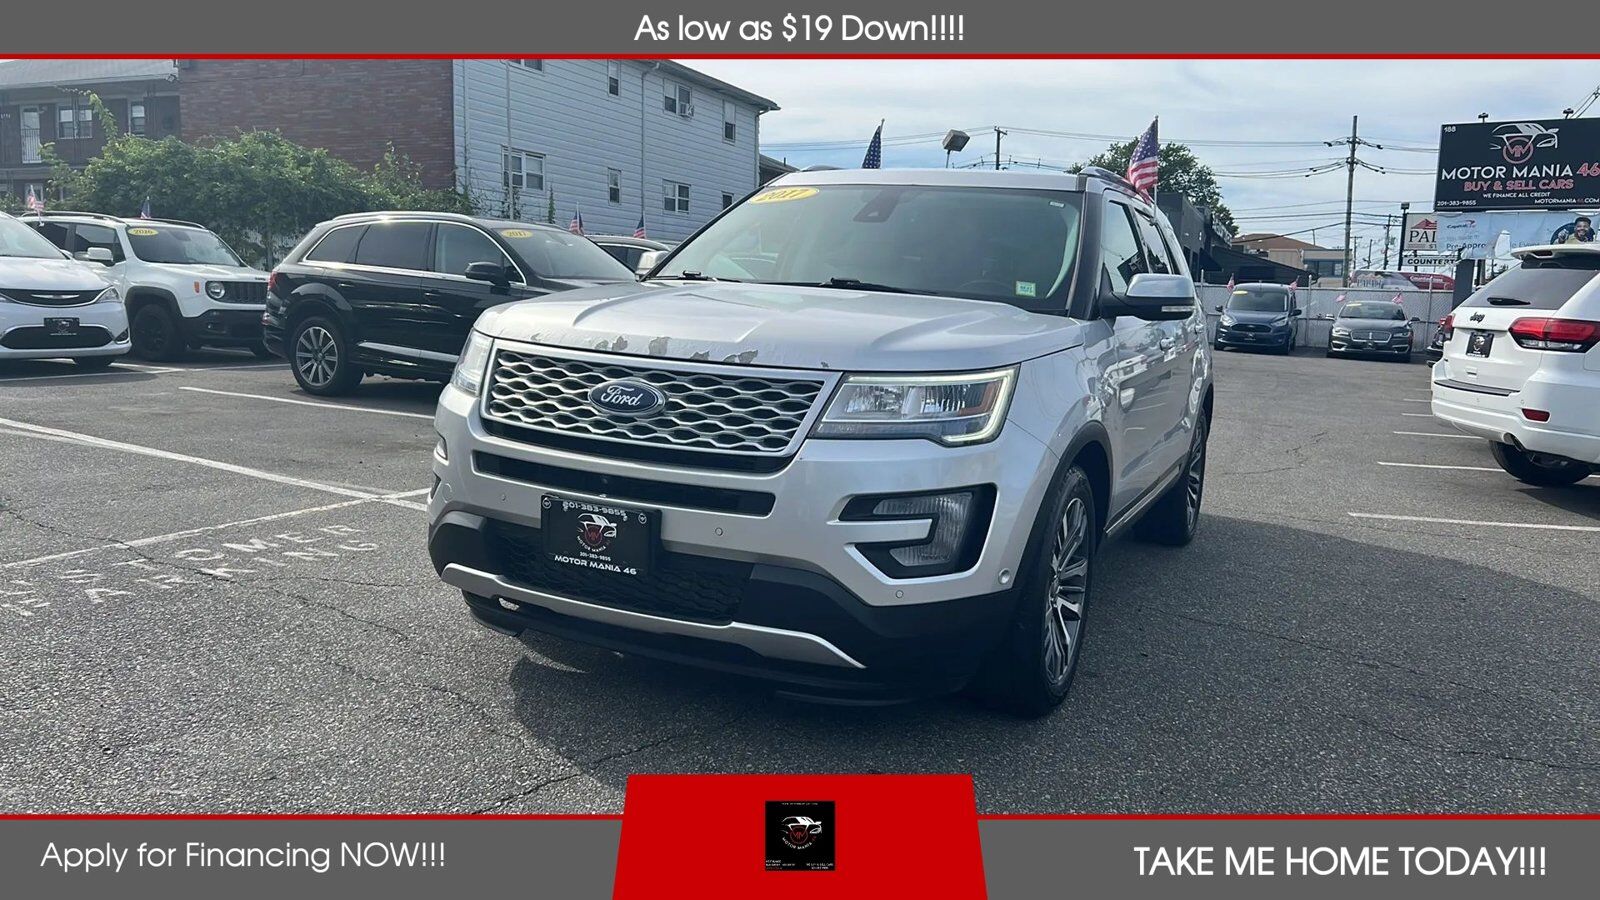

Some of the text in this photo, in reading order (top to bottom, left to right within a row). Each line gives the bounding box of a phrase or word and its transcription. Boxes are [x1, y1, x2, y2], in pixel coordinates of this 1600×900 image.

[1441, 162, 1600, 180] MOTOR MANIA 46
[1463, 178, 1574, 192] BUY & SELL CARS
[600, 385, 643, 406] Ford
[554, 555, 588, 567] MOTOR
[589, 561, 622, 573] MANIA
